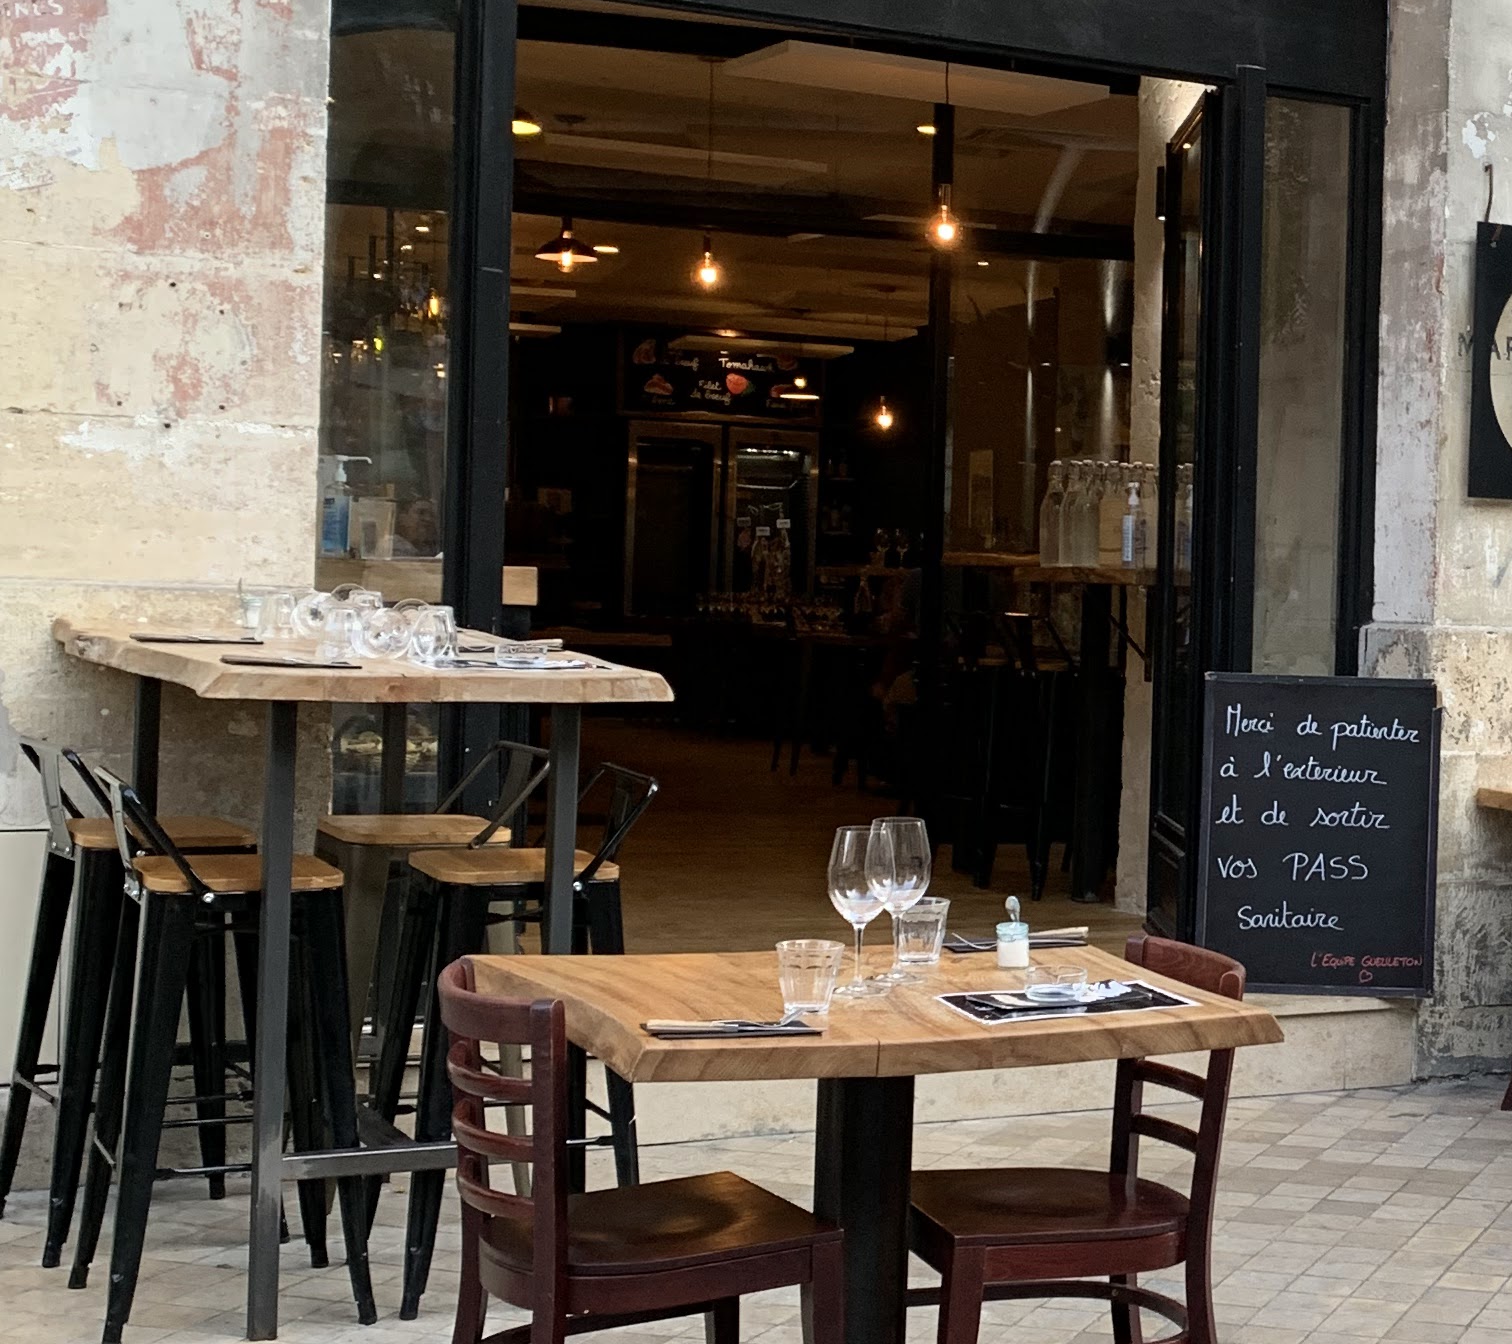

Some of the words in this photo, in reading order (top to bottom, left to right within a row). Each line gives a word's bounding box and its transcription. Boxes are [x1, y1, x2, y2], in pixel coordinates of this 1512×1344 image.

[1226, 703, 1274, 737] Merci
[1297, 714, 1322, 735] de
[1331, 714, 1420, 751] patienter
[1220, 756, 1239, 778] à
[1215, 794, 1244, 824] et
[1261, 800, 1289, 826] de
[1309, 801, 1390, 829] sortir
[1282, 852, 1369, 881] PASS
[1237, 900, 1345, 931] Sanitaire
